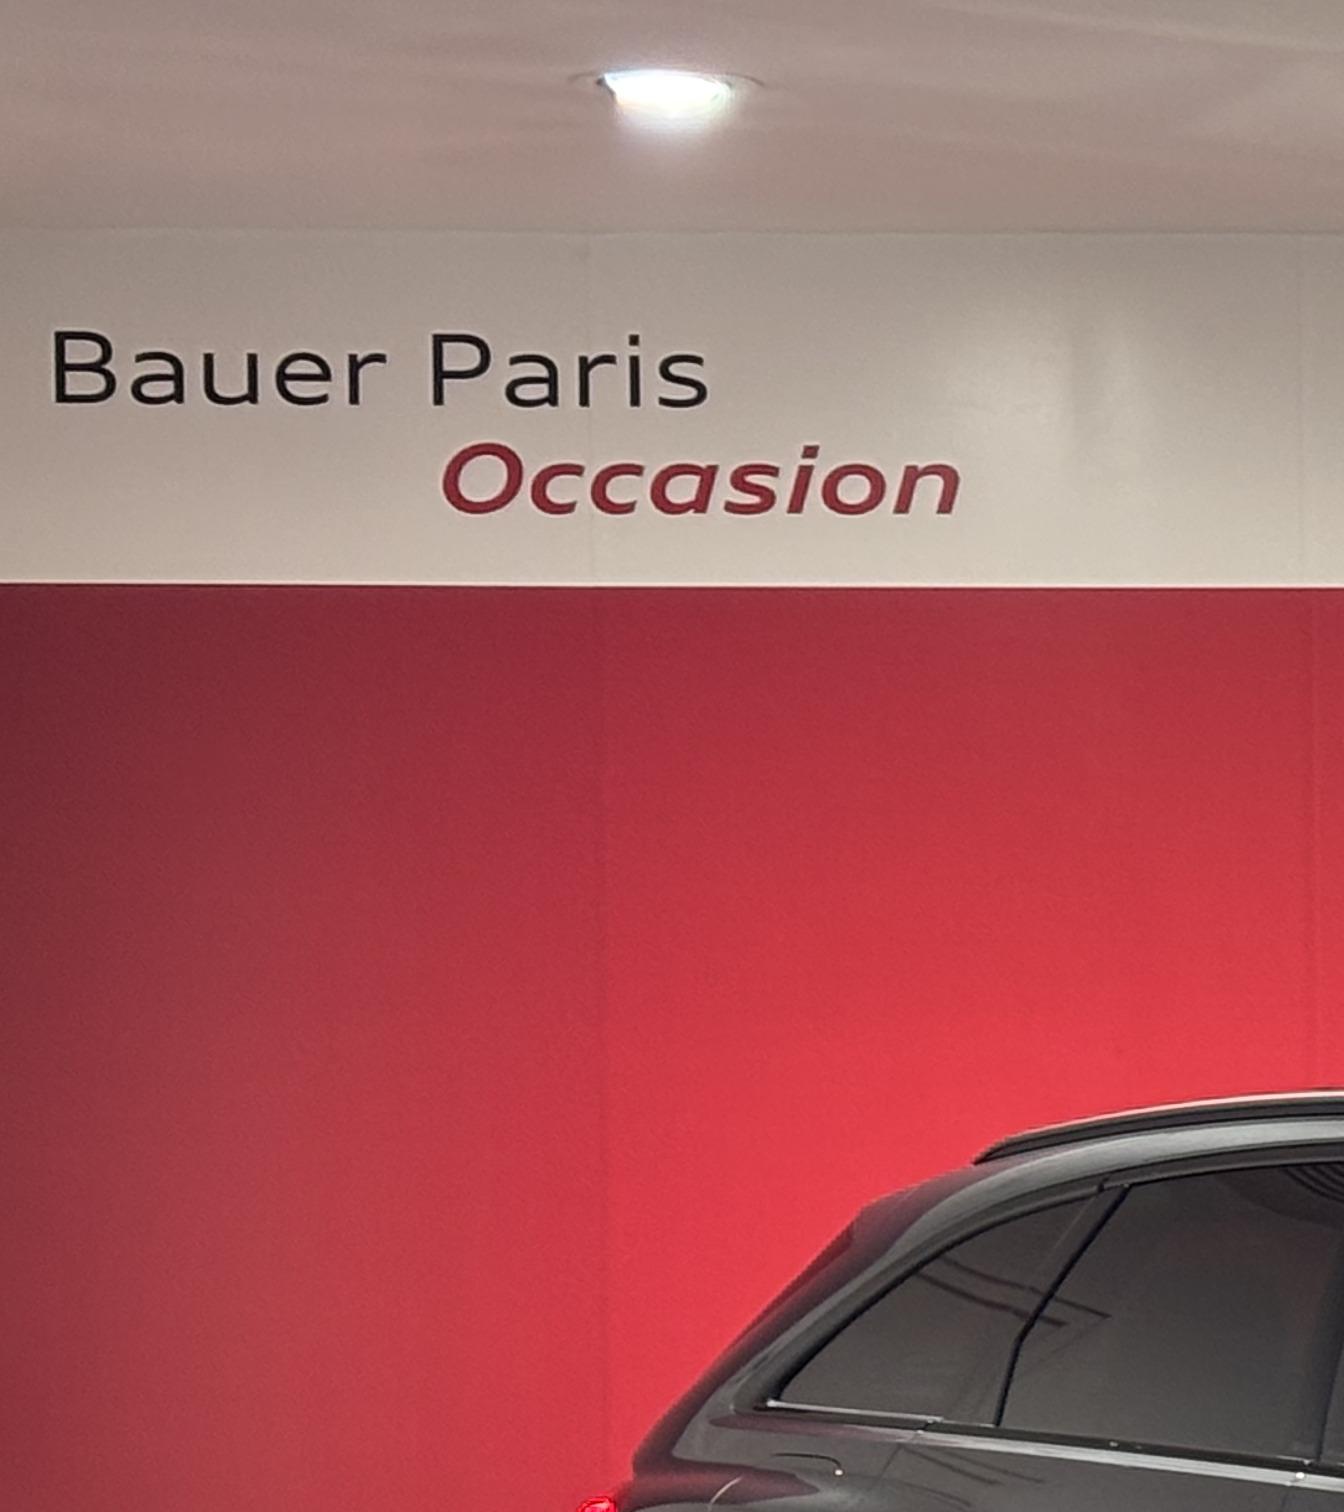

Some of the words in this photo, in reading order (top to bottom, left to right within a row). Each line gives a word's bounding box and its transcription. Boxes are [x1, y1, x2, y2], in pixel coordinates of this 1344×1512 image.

[54, 331, 386, 406] Bauer
[433, 334, 707, 408] Paris
[442, 443, 960, 516] Occasion
